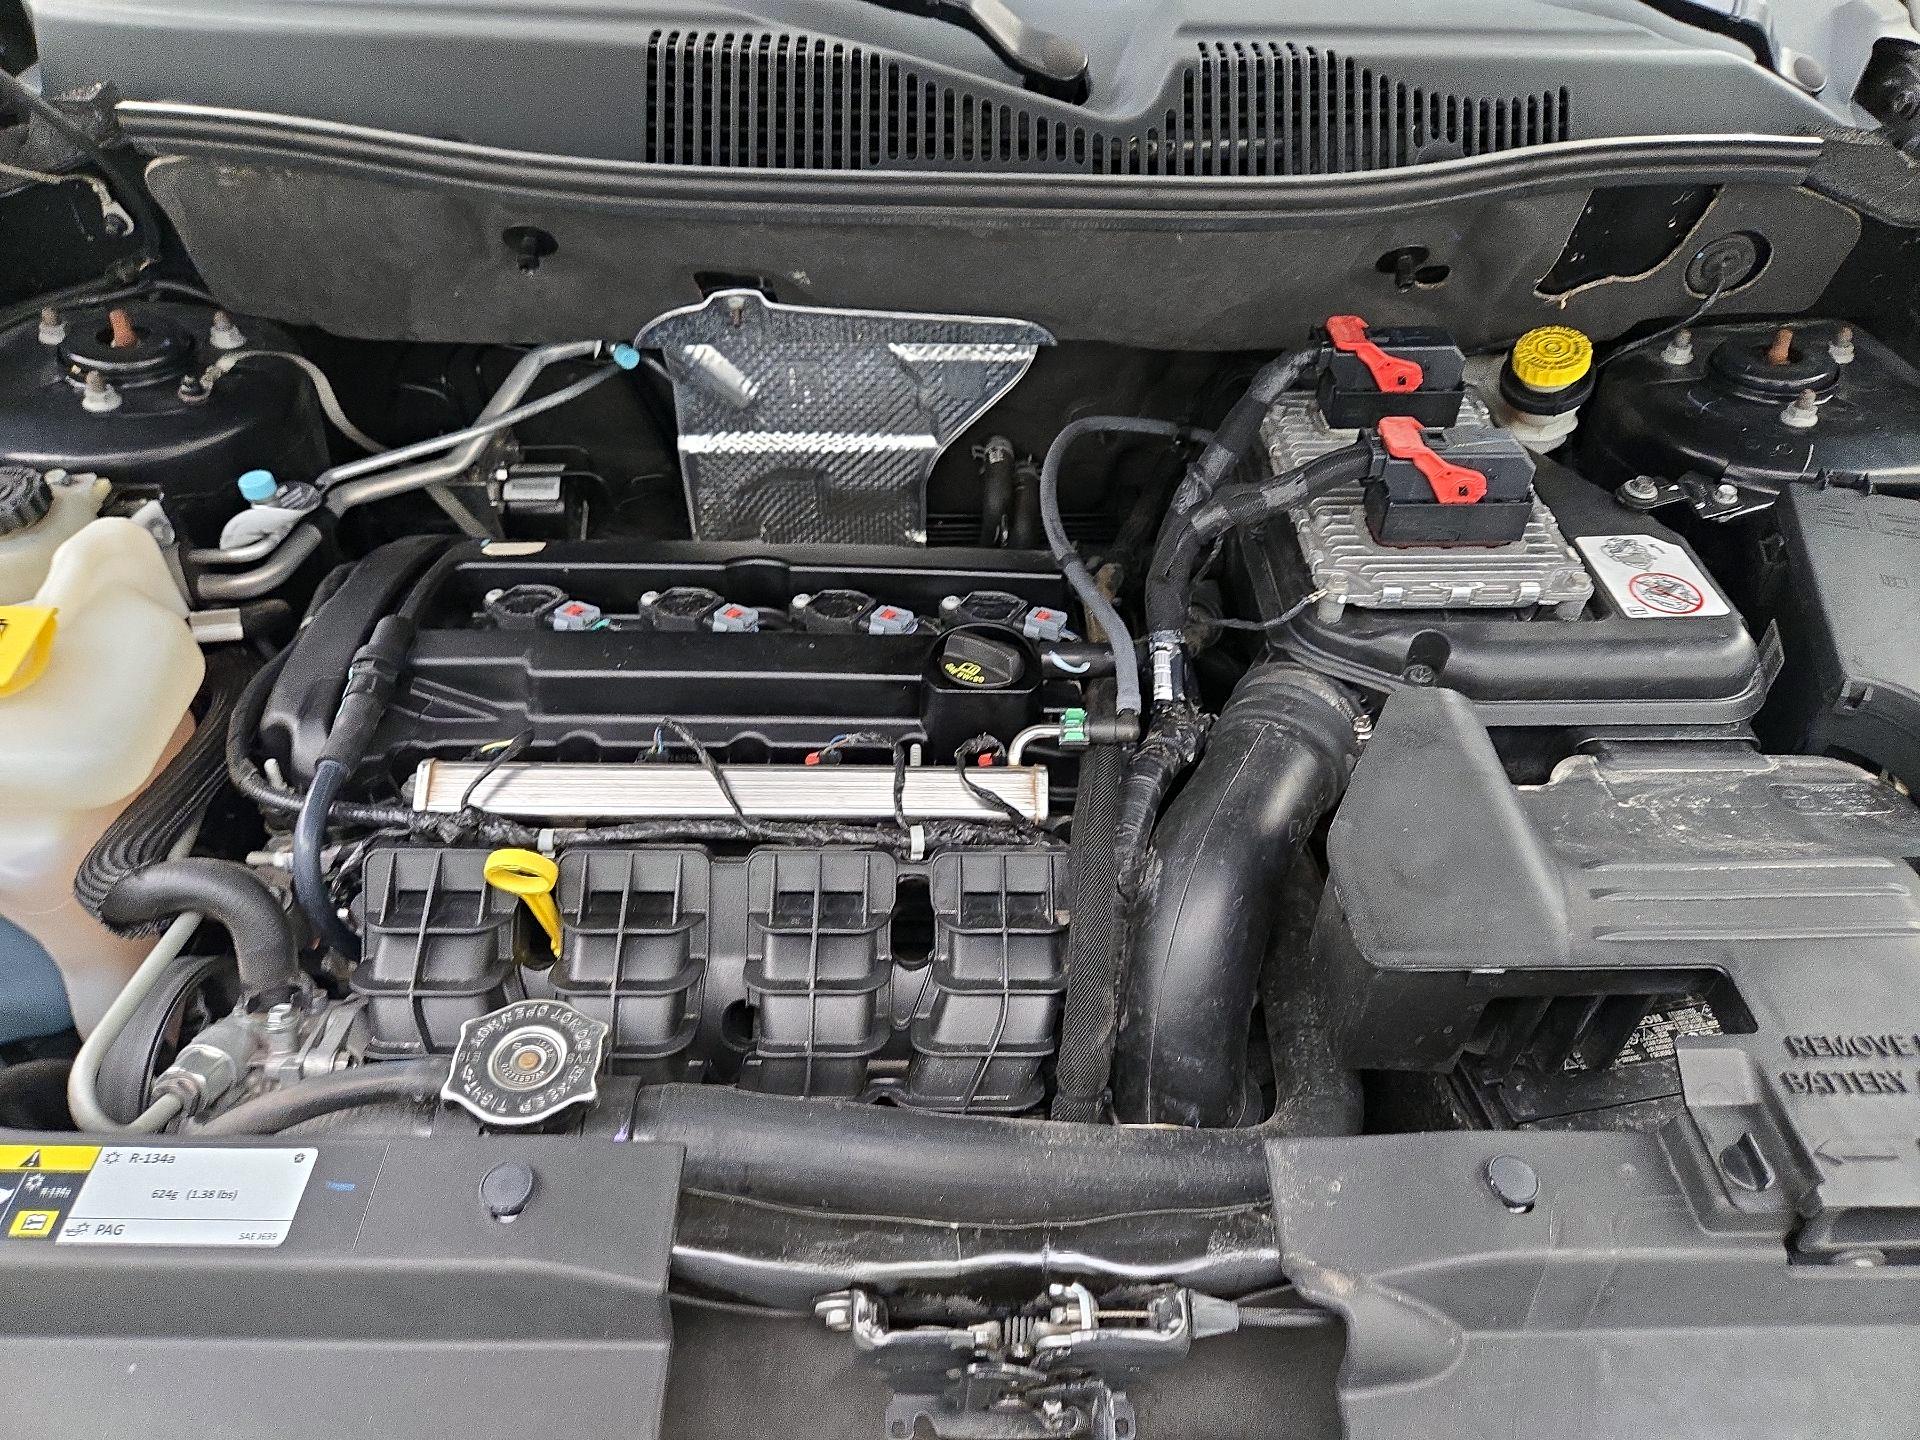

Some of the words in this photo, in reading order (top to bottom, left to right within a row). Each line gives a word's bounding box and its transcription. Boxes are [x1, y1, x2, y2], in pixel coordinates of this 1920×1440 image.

[1782, 1034, 1914, 1057] REMOVE
[1779, 1070, 1908, 1095] BATTERY
[129, 1153, 176, 1164] R-134a
[151, 1189, 180, 1201] 624g
[186, 1189, 215, 1201] (1.38
[217, 1189, 239, 1202] lbs)
[94, 1223, 126, 1236] PAG
